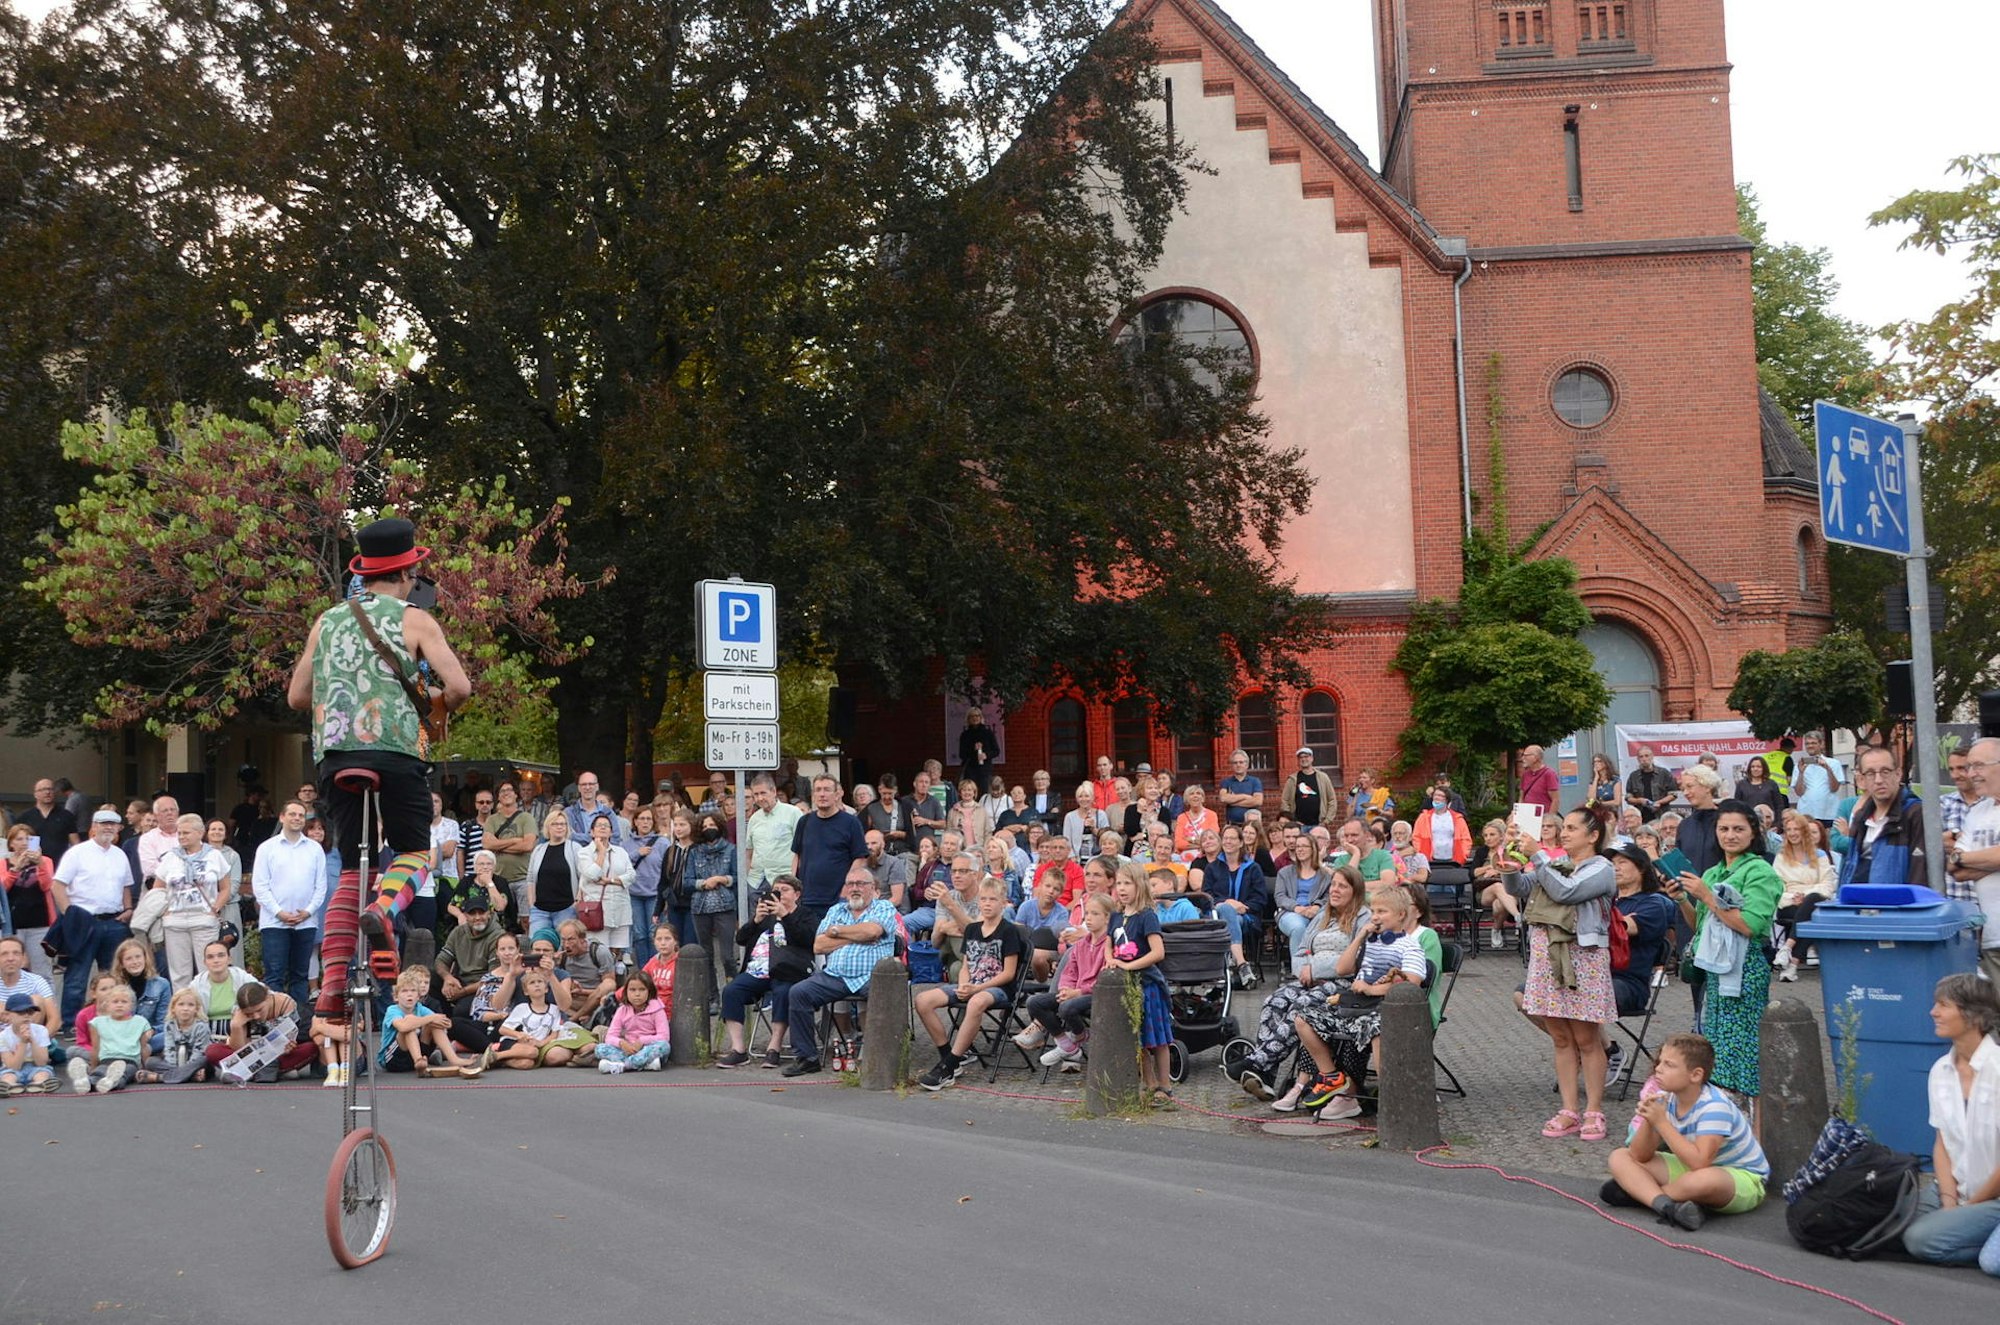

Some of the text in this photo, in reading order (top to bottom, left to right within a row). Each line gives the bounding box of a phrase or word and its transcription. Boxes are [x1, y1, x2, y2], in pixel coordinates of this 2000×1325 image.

[729, 599, 750, 635] P
[723, 648, 758, 663] ZONE
[733, 684, 750, 695] mit
[712, 698, 772, 711] Parkschein
[712, 731, 740, 744] Mo-Fr
[1661, 744, 1678, 753] DAS
[1681, 743, 1704, 753] NEUE
[712, 749, 724, 761] Sa
